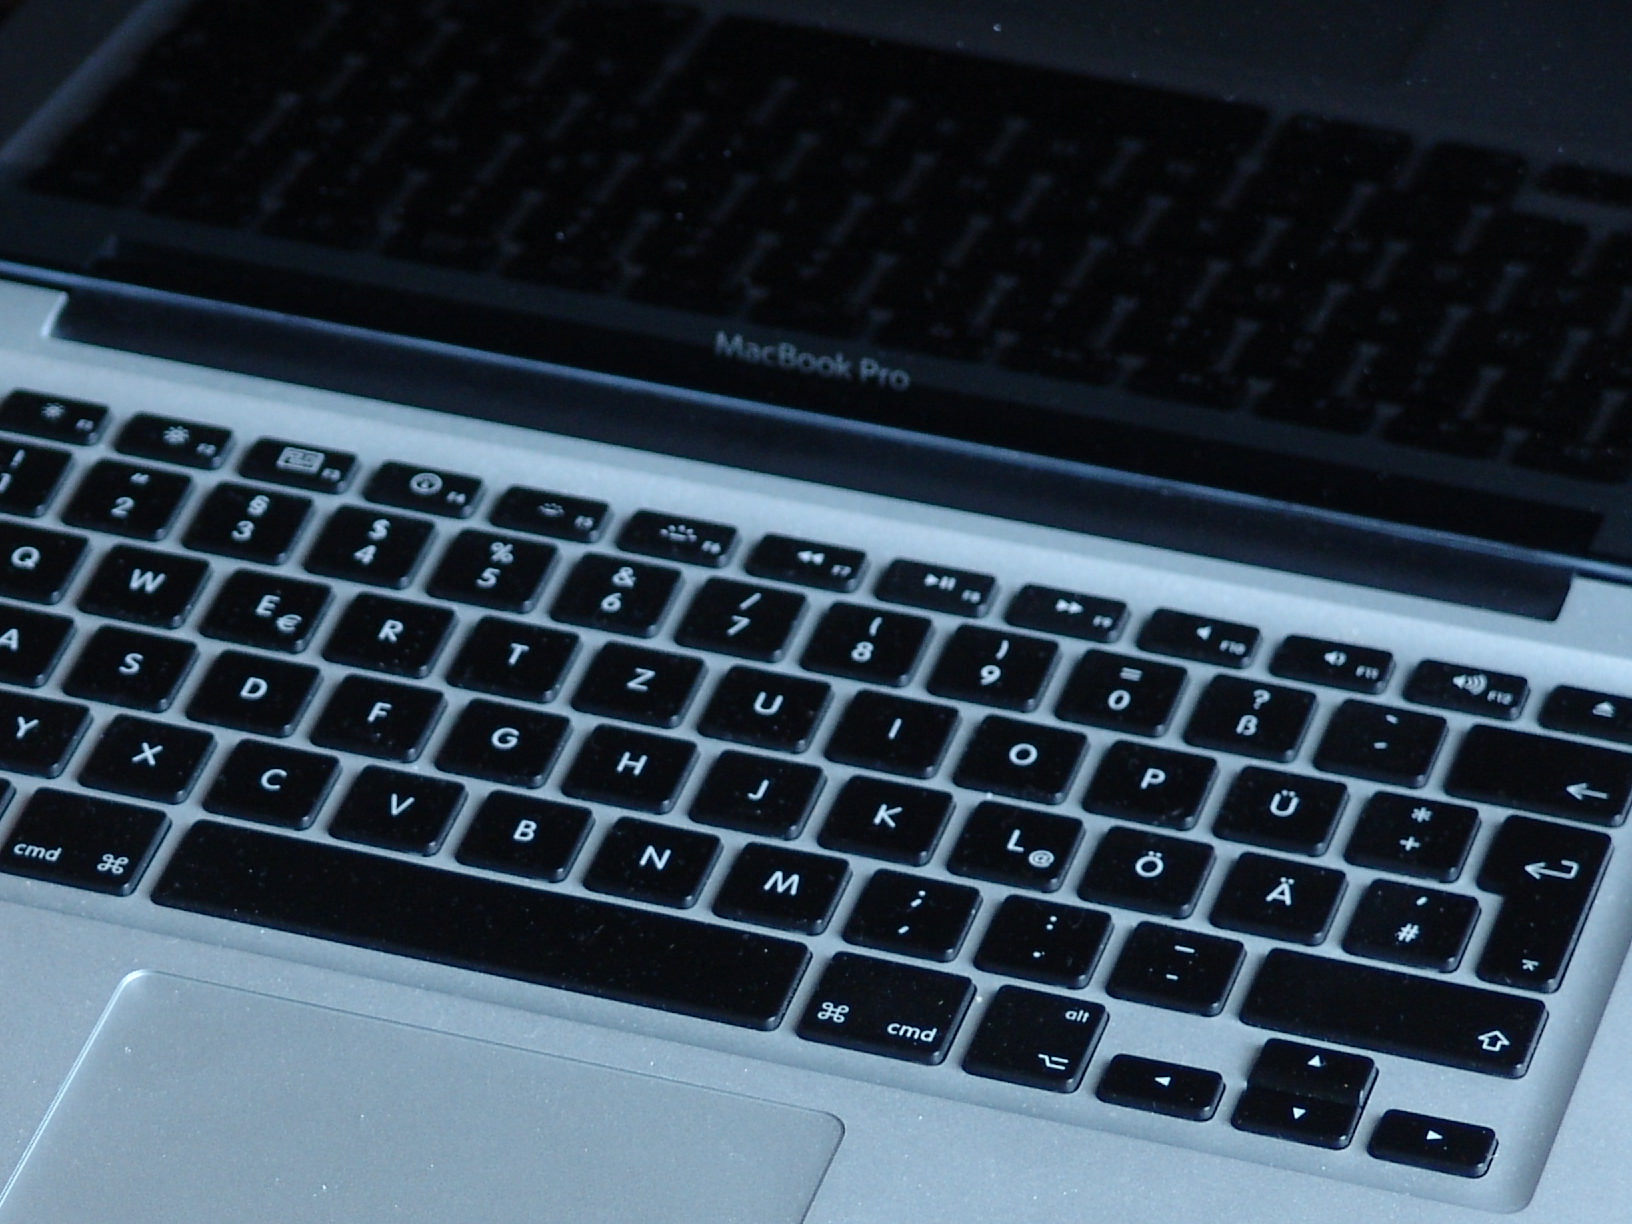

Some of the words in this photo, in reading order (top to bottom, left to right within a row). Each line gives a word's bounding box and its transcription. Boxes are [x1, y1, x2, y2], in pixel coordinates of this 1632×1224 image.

[715, 330, 852, 380] MacBook
[859, 356, 911, 392] Pro
[110, 496, 136, 519] 2
[231, 520, 256, 542] 3
[10, 546, 41, 571] Q
[353, 544, 378, 566] 4
[489, 541, 515, 565] %
[128, 568, 167, 595] W
[476, 567, 502, 589] 5
[611, 566, 638, 589] &
[254, 593, 282, 618] E
[600, 592, 624, 614] 6
[274, 612, 305, 634] €
[377, 618, 405, 644] R
[726, 614, 752, 637] 7
[117, 651, 145, 676] S
[507, 641, 531, 667] T
[850, 640, 876, 664] 8
[238, 675, 269, 700] D
[625, 667, 658, 692] Z
[980, 664, 1003, 687] 9
[366, 700, 394, 724] F
[752, 690, 785, 717] U
[1252, 688, 1273, 711] ?
[15, 715, 41, 740] Y
[489, 725, 521, 751] G
[130, 741, 165, 768] X
[615, 750, 649, 778] H
[1007, 741, 1039, 768] O
[259, 767, 289, 792] C
[746, 778, 771, 802] J
[1139, 766, 1167, 791] P
[389, 792, 417, 818] V
[872, 802, 904, 830] K
[1268, 788, 1301, 819] Ü
[511, 818, 539, 843] B
[1005, 827, 1026, 854] L
[12, 841, 65, 863] cmd
[637, 843, 673, 872] N
[1026, 848, 1056, 869] @
[1133, 849, 1166, 879] Ö
[761, 869, 802, 897] M
[1264, 875, 1296, 908] Ä
[1393, 921, 1421, 944] #
[1063, 1007, 1091, 1025] alt
[885, 1019, 939, 1045] cmd
